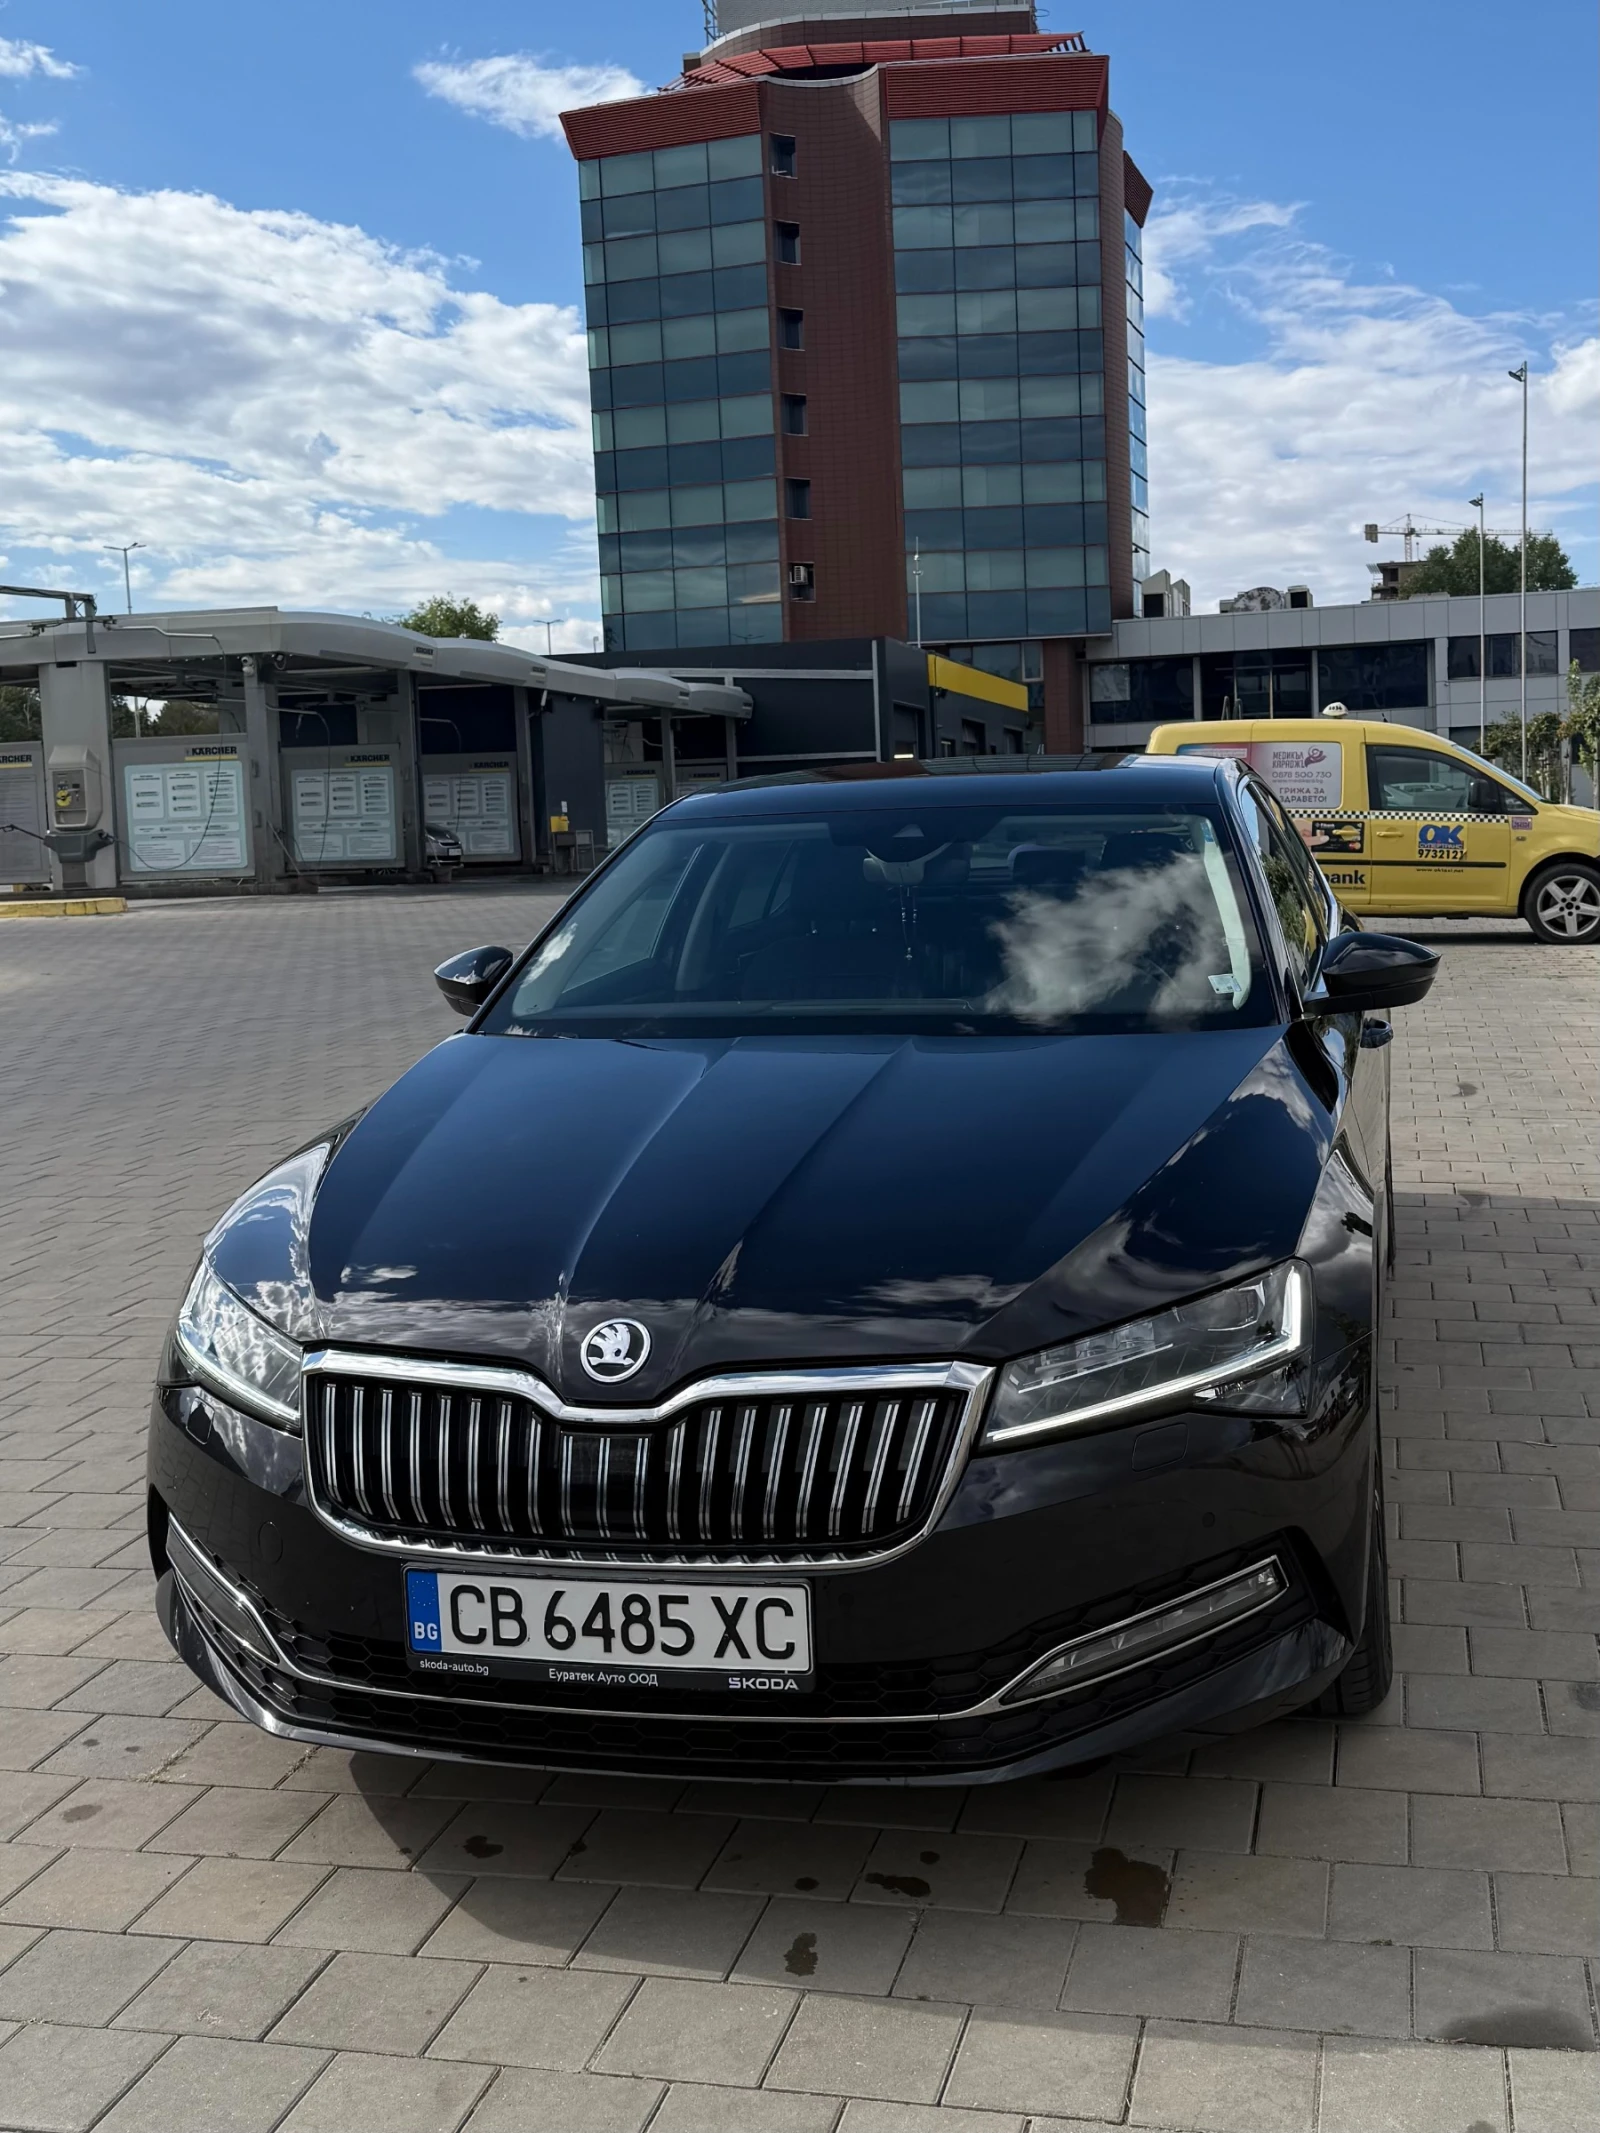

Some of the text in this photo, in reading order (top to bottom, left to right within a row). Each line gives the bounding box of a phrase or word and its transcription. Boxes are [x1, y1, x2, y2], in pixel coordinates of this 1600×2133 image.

[1279, 787, 1325, 795] ГРИЖА ЗА
[413, 1620, 439, 1641] BG
[449, 1584, 797, 1661] CB 6485 XC
[419, 1659, 489, 1675] skoda-auto.bg
[548, 1668, 659, 1687] Еуратек Ауто ООД
